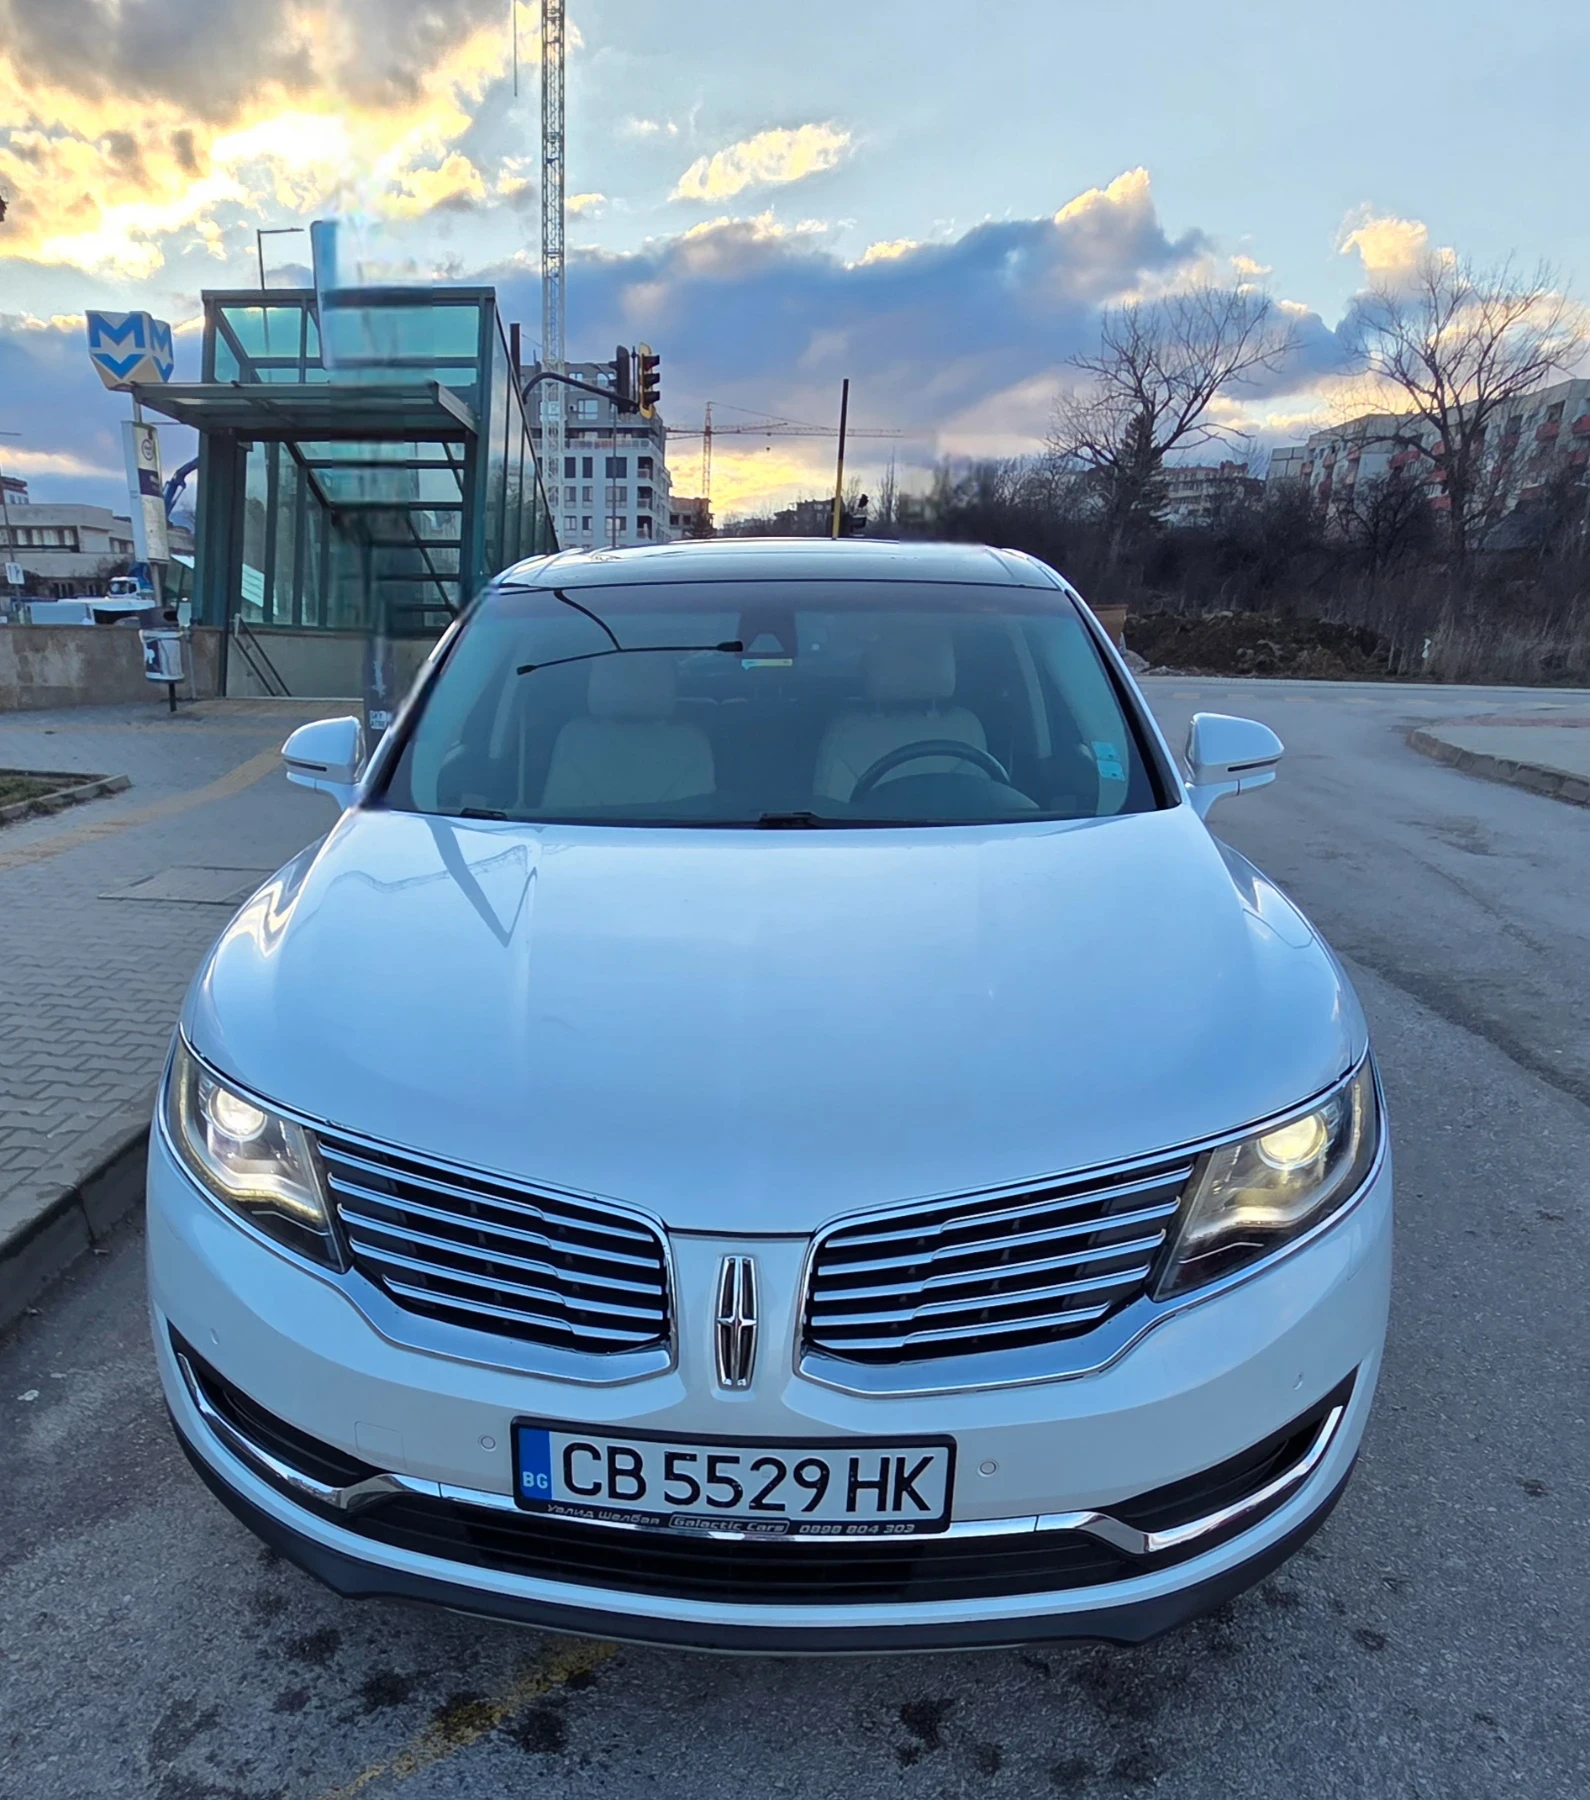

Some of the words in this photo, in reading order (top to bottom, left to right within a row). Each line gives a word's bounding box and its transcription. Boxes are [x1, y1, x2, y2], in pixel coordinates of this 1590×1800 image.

[522, 1471, 549, 1489] BG
[563, 1442, 647, 1500] CB
[664, 1451, 830, 1513] 5529
[846, 1456, 935, 1512] HK
[673, 1518, 743, 1531] Galactic
[746, 1522, 785, 1532] Cars
[799, 1524, 843, 1535] 0898
[846, 1524, 880, 1534] 804
[883, 1523, 916, 1534] 303
